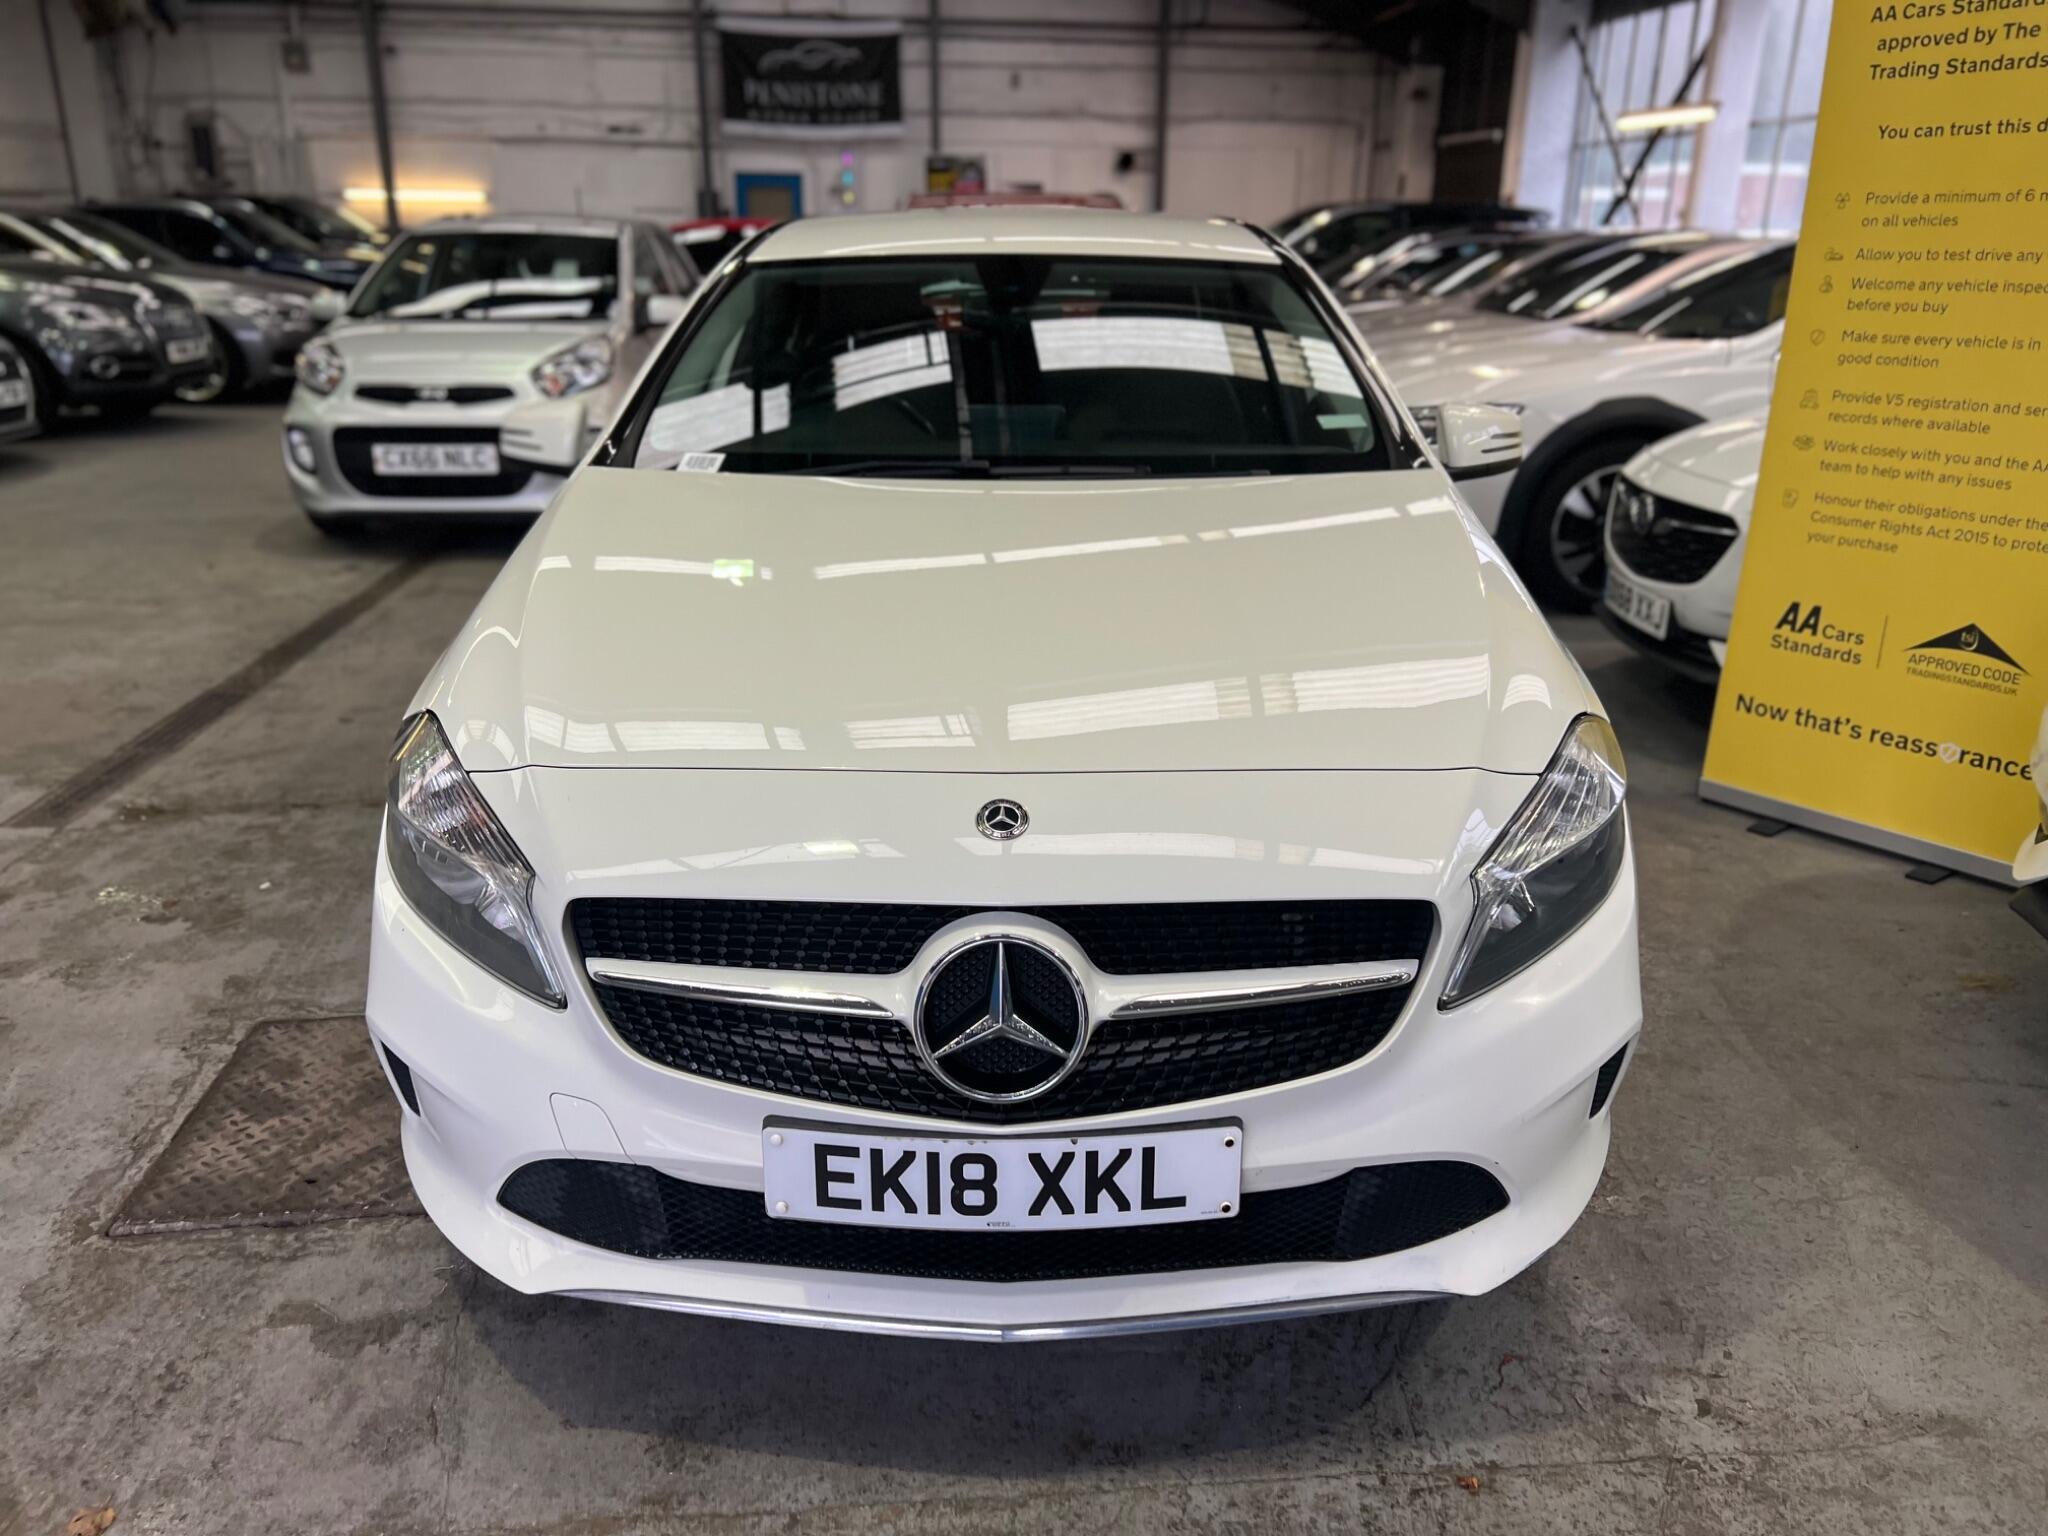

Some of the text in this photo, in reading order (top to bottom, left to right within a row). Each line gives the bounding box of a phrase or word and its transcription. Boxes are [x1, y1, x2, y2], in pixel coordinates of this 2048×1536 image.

[1871, 5, 1897, 22] AA
[1903, 3, 1945, 20] Cars
[1877, 22, 2041, 53] approved by The
[1869, 51, 2048, 80] Trading Standards
[1879, 124, 1908, 139] You
[1914, 125, 1944, 138] can
[1950, 120, 1991, 136] trust
[1997, 118, 2031, 134] this
[1866, 191, 1919, 205] Provide
[1922, 195, 1929, 204] a
[1934, 190, 2000, 204] minimum
[2005, 189, 2022, 202] of
[2025, 189, 2035, 201] 6
[1862, 213, 1958, 227] on all vehicles
[1856, 248, 2043, 264] Allow you to test drive any
[1851, 277, 1915, 291] Welcome
[1919, 281, 1943, 294] any
[1947, 279, 1999, 293] vehicle
[1847, 299, 1949, 315] before you buy
[1841, 330, 2041, 351] Make sure every vehicle is in
[1837, 352, 1939, 368] good condition
[1832, 389, 1882, 405] Provide
[1887, 393, 1904, 407] V5
[1907, 397, 1989, 413] registration
[1993, 402, 2020, 416] and
[1828, 411, 1991, 434] records where available
[1823, 439, 1858, 453] Work
[1861, 444, 1907, 461] closely
[1911, 448, 1941, 463] with
[1944, 453, 1970, 466] you
[1974, 455, 2002, 468] and
[2006, 457, 2029, 472] the
[1820, 460, 2012, 490] team to help with any issues
[1814, 491, 2048, 532] Honour their obligations under the
[1807, 531, 1898, 554] your purchase
[1810, 511, 1875, 529] Consumer
[1880, 520, 1923, 537] Rights
[1926, 526, 1950, 540] Act
[1954, 529, 1989, 545] 2015
[1993, 534, 2008, 547] to
[1775, 601, 1864, 645] AA Cars
[1770, 633, 1862, 665] Standards
[1908, 654, 2021, 685] APPROVED CODE
[1735, 693, 1789, 722] Now
[1795, 707, 1862, 740] that's
[814, 1143, 1187, 1217] EK18 XKL
